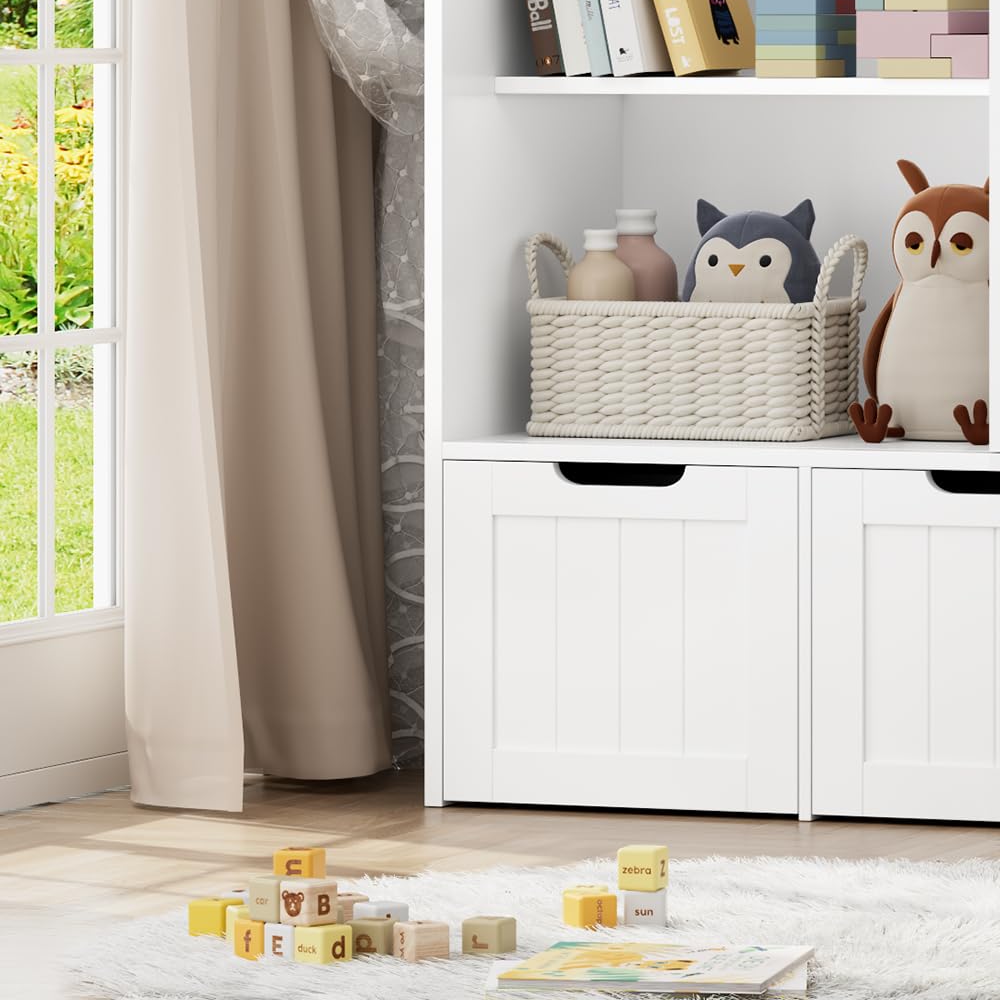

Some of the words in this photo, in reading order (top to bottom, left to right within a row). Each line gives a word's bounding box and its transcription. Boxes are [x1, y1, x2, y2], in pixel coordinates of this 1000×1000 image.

[622, 866, 652, 875] zebra
[317, 894, 331, 917] B
[634, 907, 654, 917] sun
[243, 929, 252, 953] f
[272, 935, 284, 956] E
[297, 944, 317, 955] duck
[331, 935, 346, 960] d
